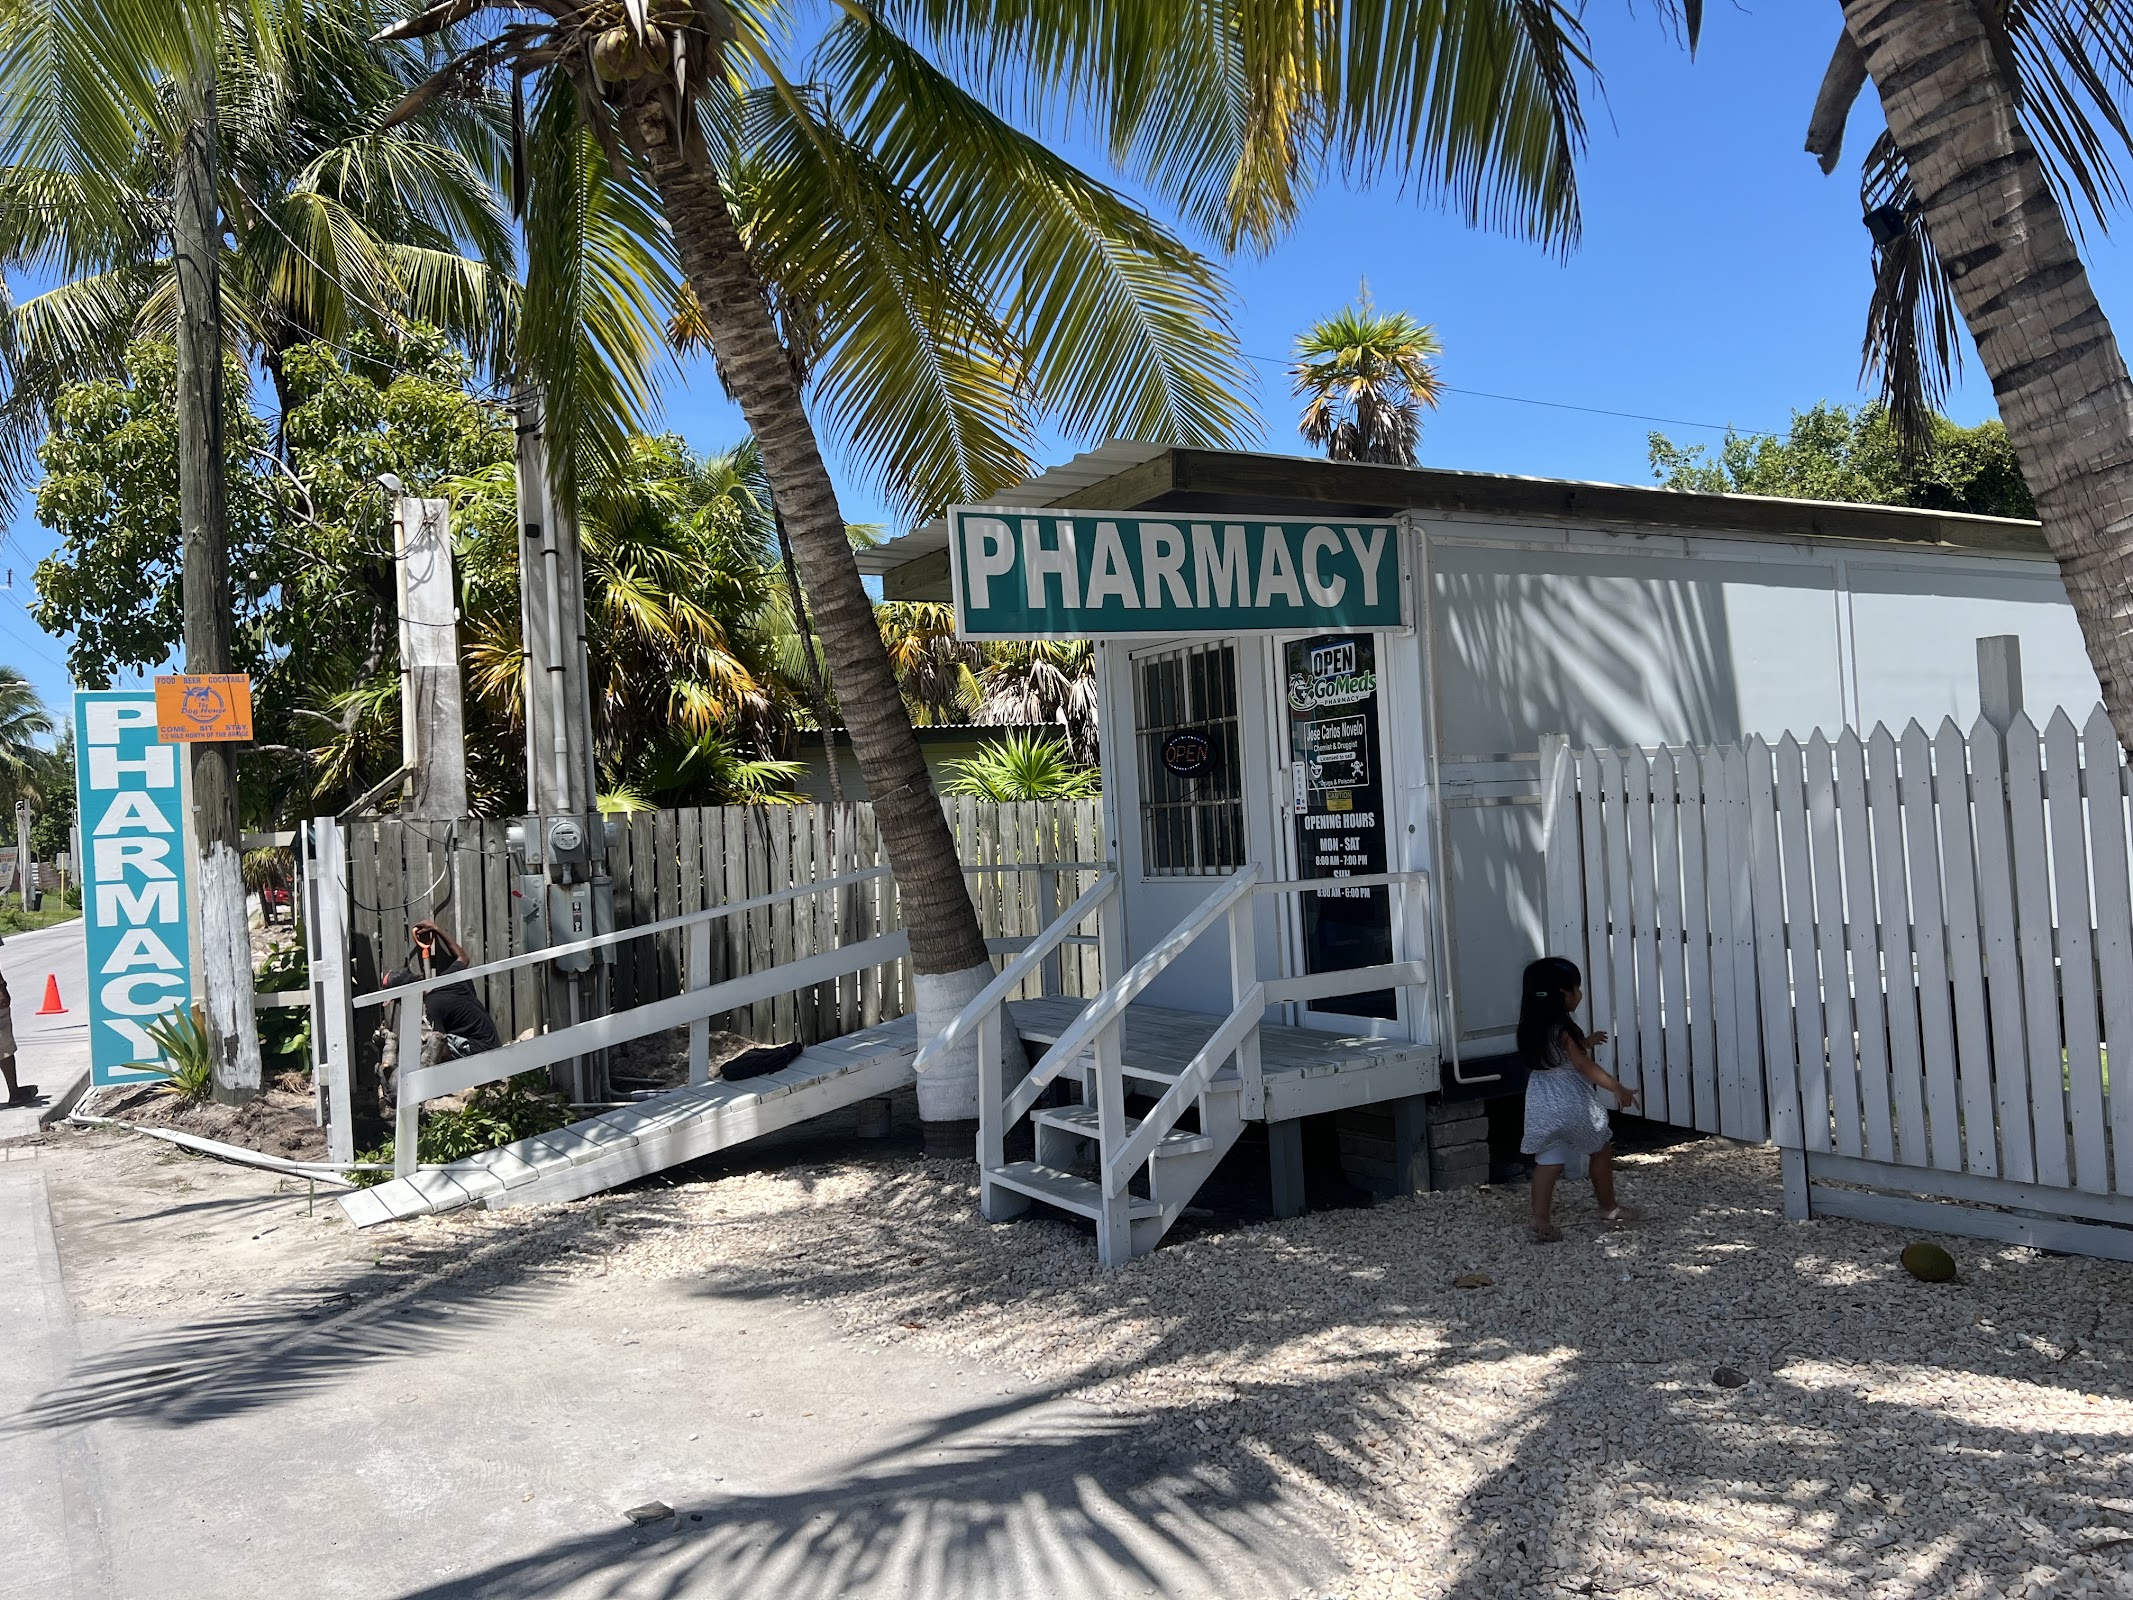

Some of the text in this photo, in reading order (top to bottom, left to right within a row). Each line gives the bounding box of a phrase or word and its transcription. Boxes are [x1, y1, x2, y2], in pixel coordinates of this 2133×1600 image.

[963, 516, 1388, 610] PHARMACY
[1313, 646, 1353, 677] OPEN
[157, 677, 176, 685] FOOD
[208, 676, 246, 684] COCKTAILS
[1314, 669, 1377, 699] GoMeds
[1324, 695, 1360, 705] PHARMACY
[181, 706, 227, 715] Dog House
[160, 725, 188, 733] COME.
[1307, 720, 1364, 742] Jose Carlos Novelo
[1313, 743, 1333, 752] Chemist
[1337, 740, 1358, 750] Druggist
[1165, 744, 1208, 763] OPEN
[1327, 791, 1351, 799] CAUTION
[1304, 812, 1375, 830] OPENING HOURS
[1320, 837, 1339, 851] MON
[1344, 837, 1360, 851] SAT
[1315, 855, 1329, 865] 8:00
[1329, 855, 1340, 865] AM
[1343, 855, 1357, 865] 7:00
[1357, 854, 1368, 865] PM
[85, 701, 187, 1060] PHARMACY
[1331, 887, 1341, 898] AM
[1344, 887, 1360, 898] 6:00
[1360, 887, 1371, 898] PM
